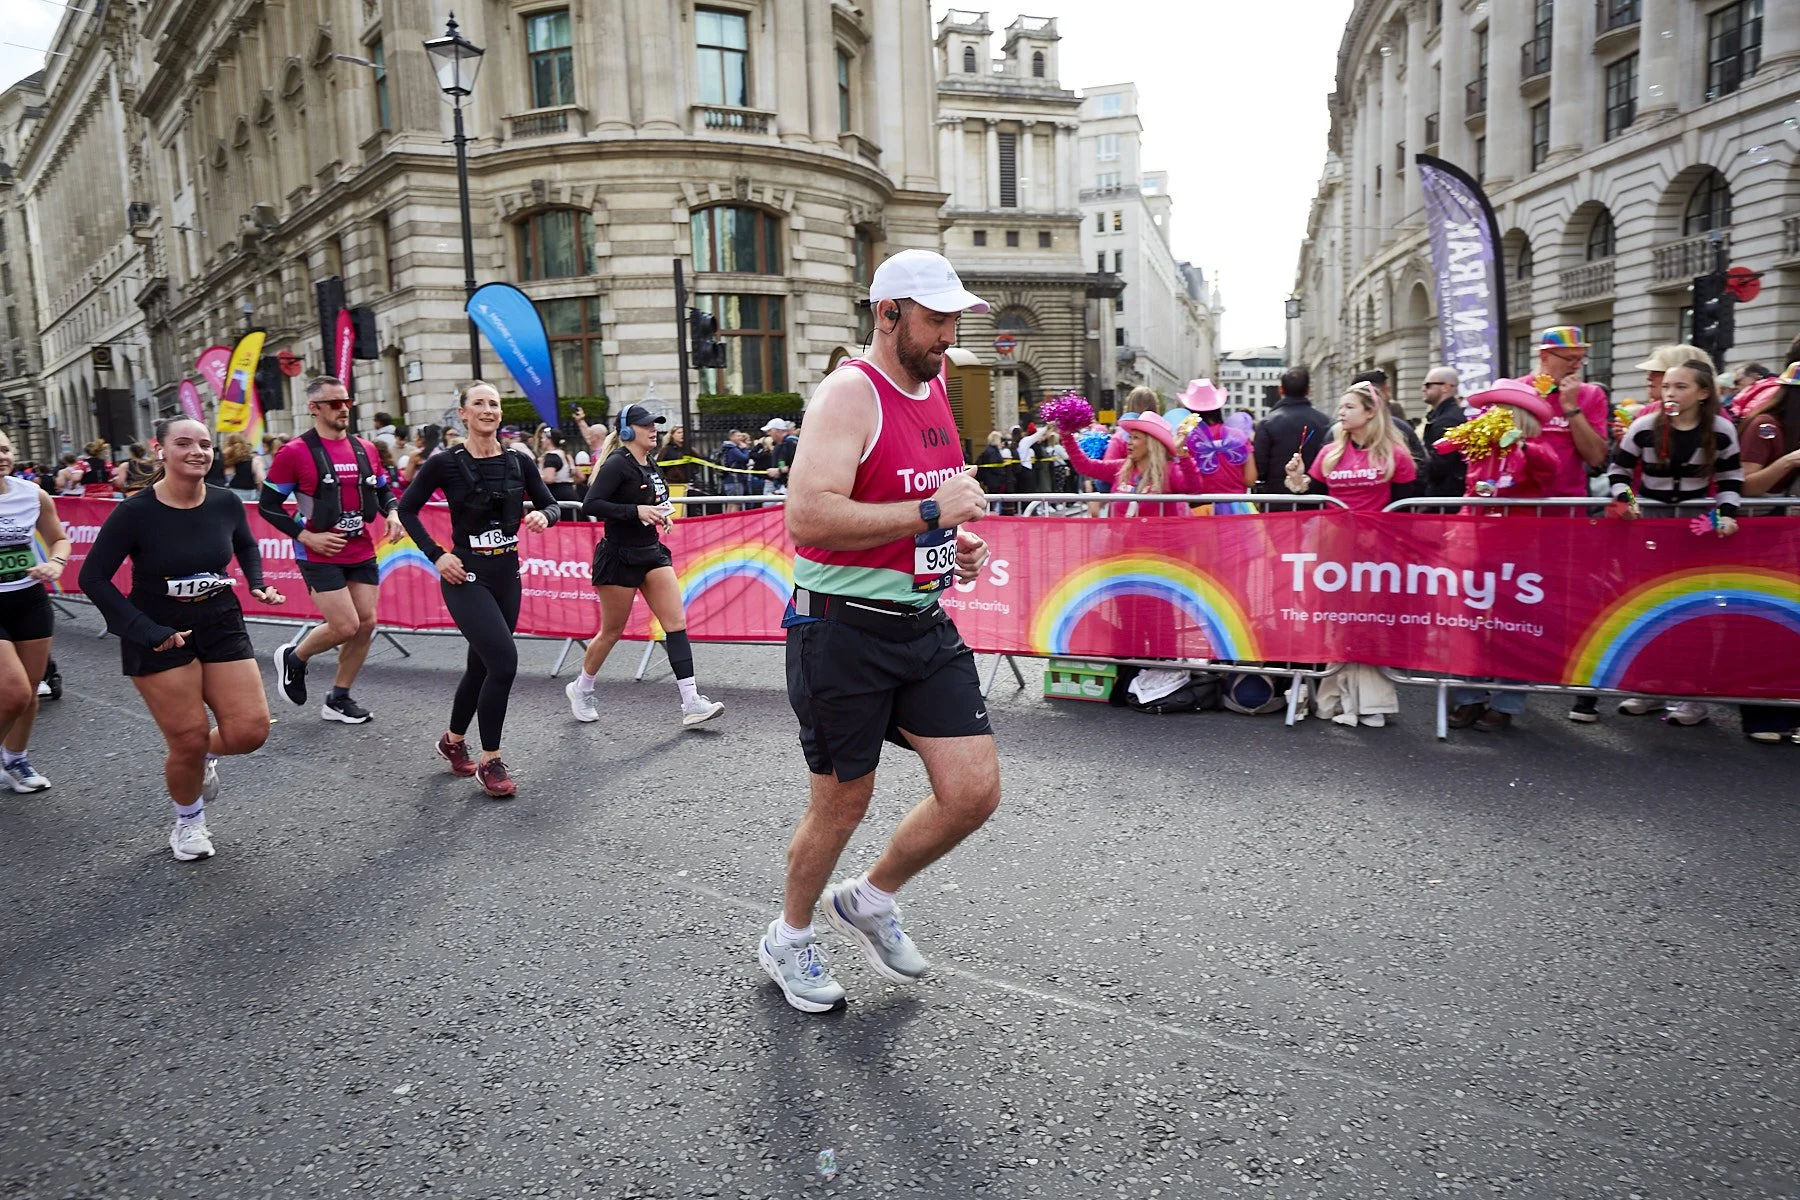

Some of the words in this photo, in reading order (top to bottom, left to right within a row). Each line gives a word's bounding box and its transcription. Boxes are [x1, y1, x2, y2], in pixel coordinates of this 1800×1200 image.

[925, 543, 957, 571] 936
[1281, 552, 1545, 610] Tommy's
[968, 598, 1010, 615] charity
[1280, 607, 1309, 621] The
[1312, 611, 1396, 627] pregnancy
[1399, 612, 1432, 625] and
[1435, 612, 1479, 631] baby
[1483, 617, 1544, 637] charity
